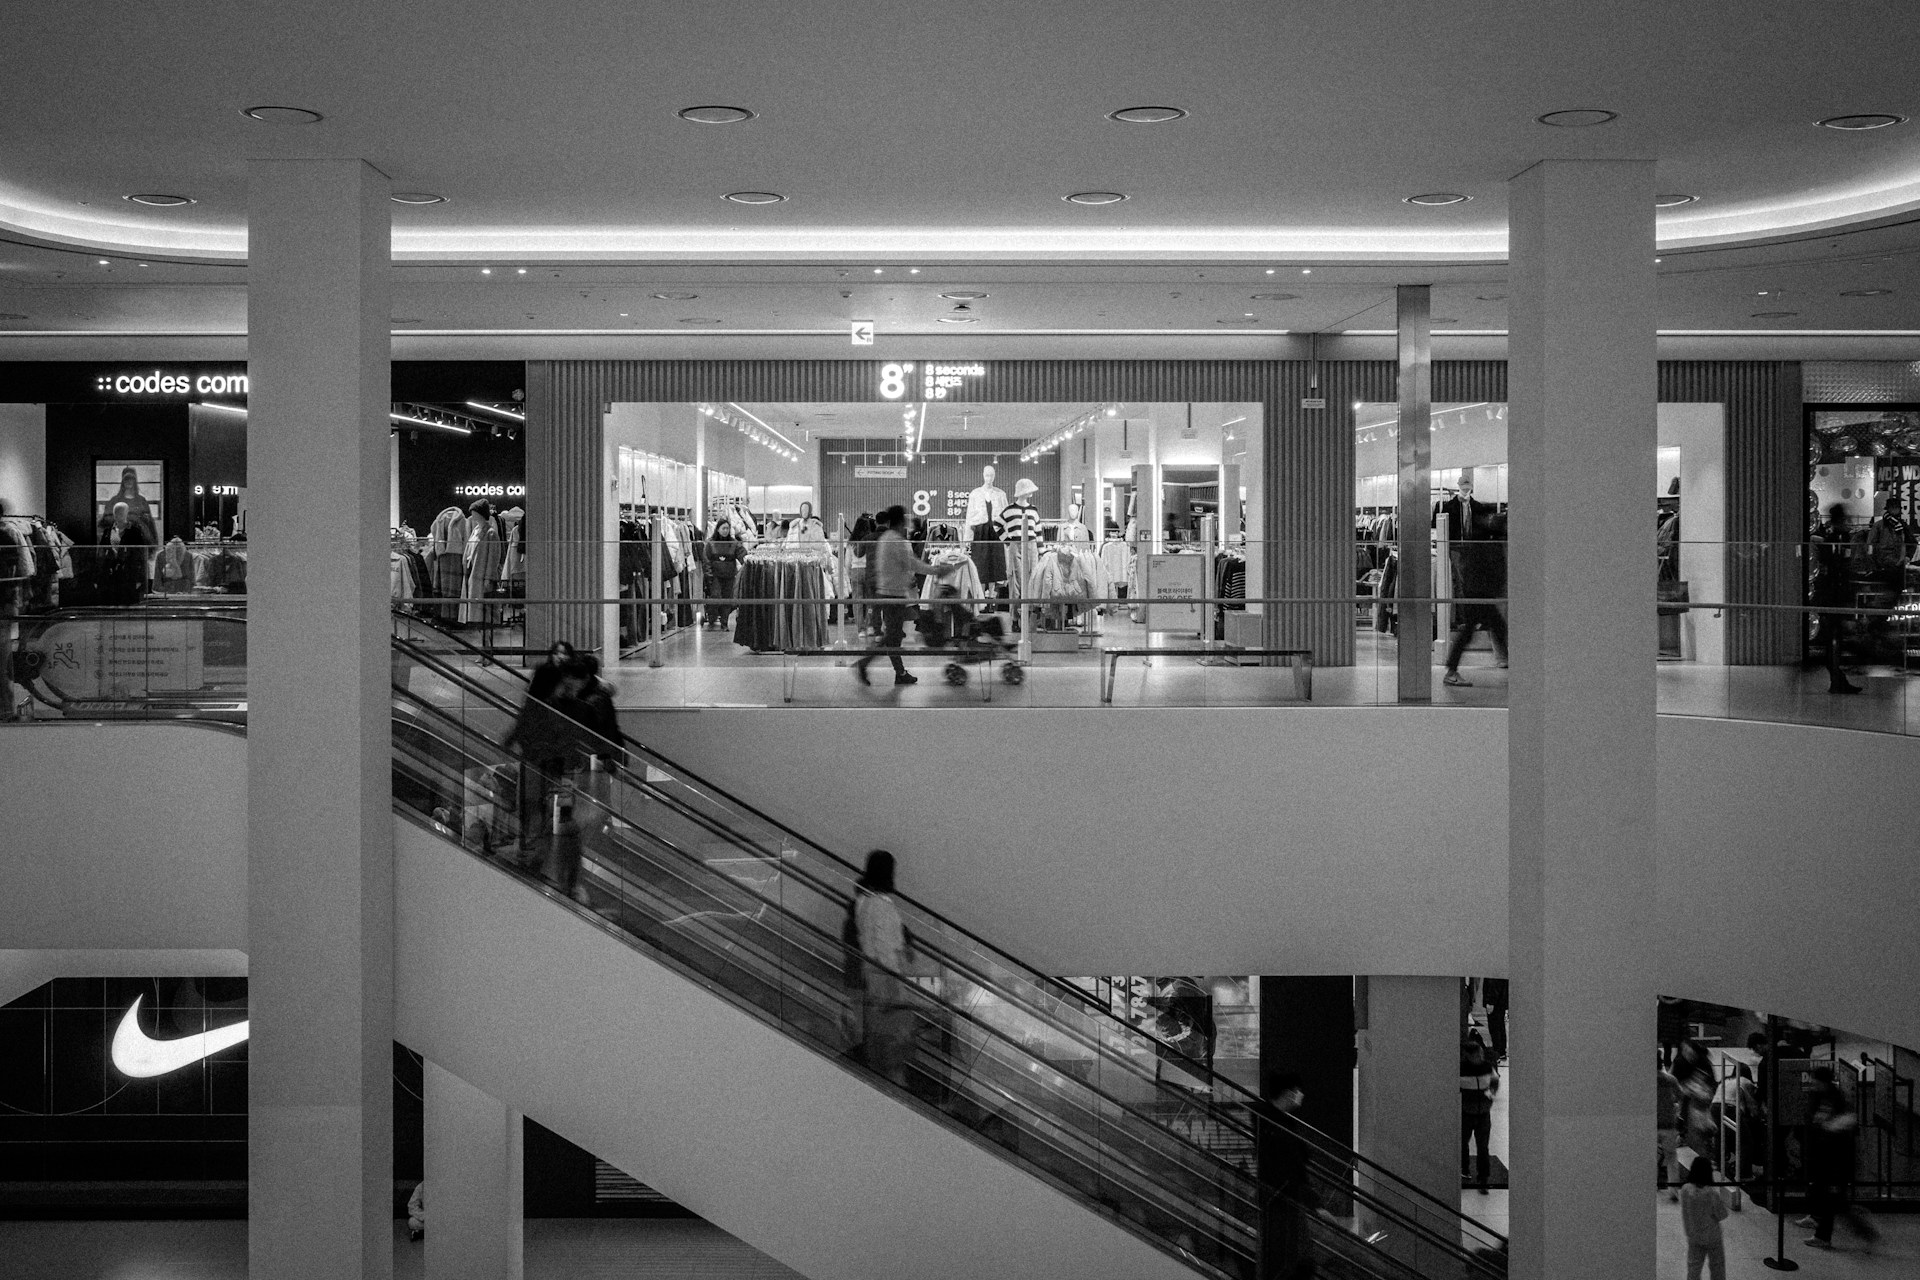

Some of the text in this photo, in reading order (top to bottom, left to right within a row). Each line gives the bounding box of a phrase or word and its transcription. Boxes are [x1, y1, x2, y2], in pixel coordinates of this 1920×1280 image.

[925, 363, 985, 376] 8 seconds
[115, 370, 190, 394] codes
[925, 376, 934, 387] 8
[925, 388, 934, 399] 8
[465, 483, 525, 496] codes co
[947, 490, 953, 499] 8
[947, 499, 953, 507] 8
[947, 507, 953, 516] 8
